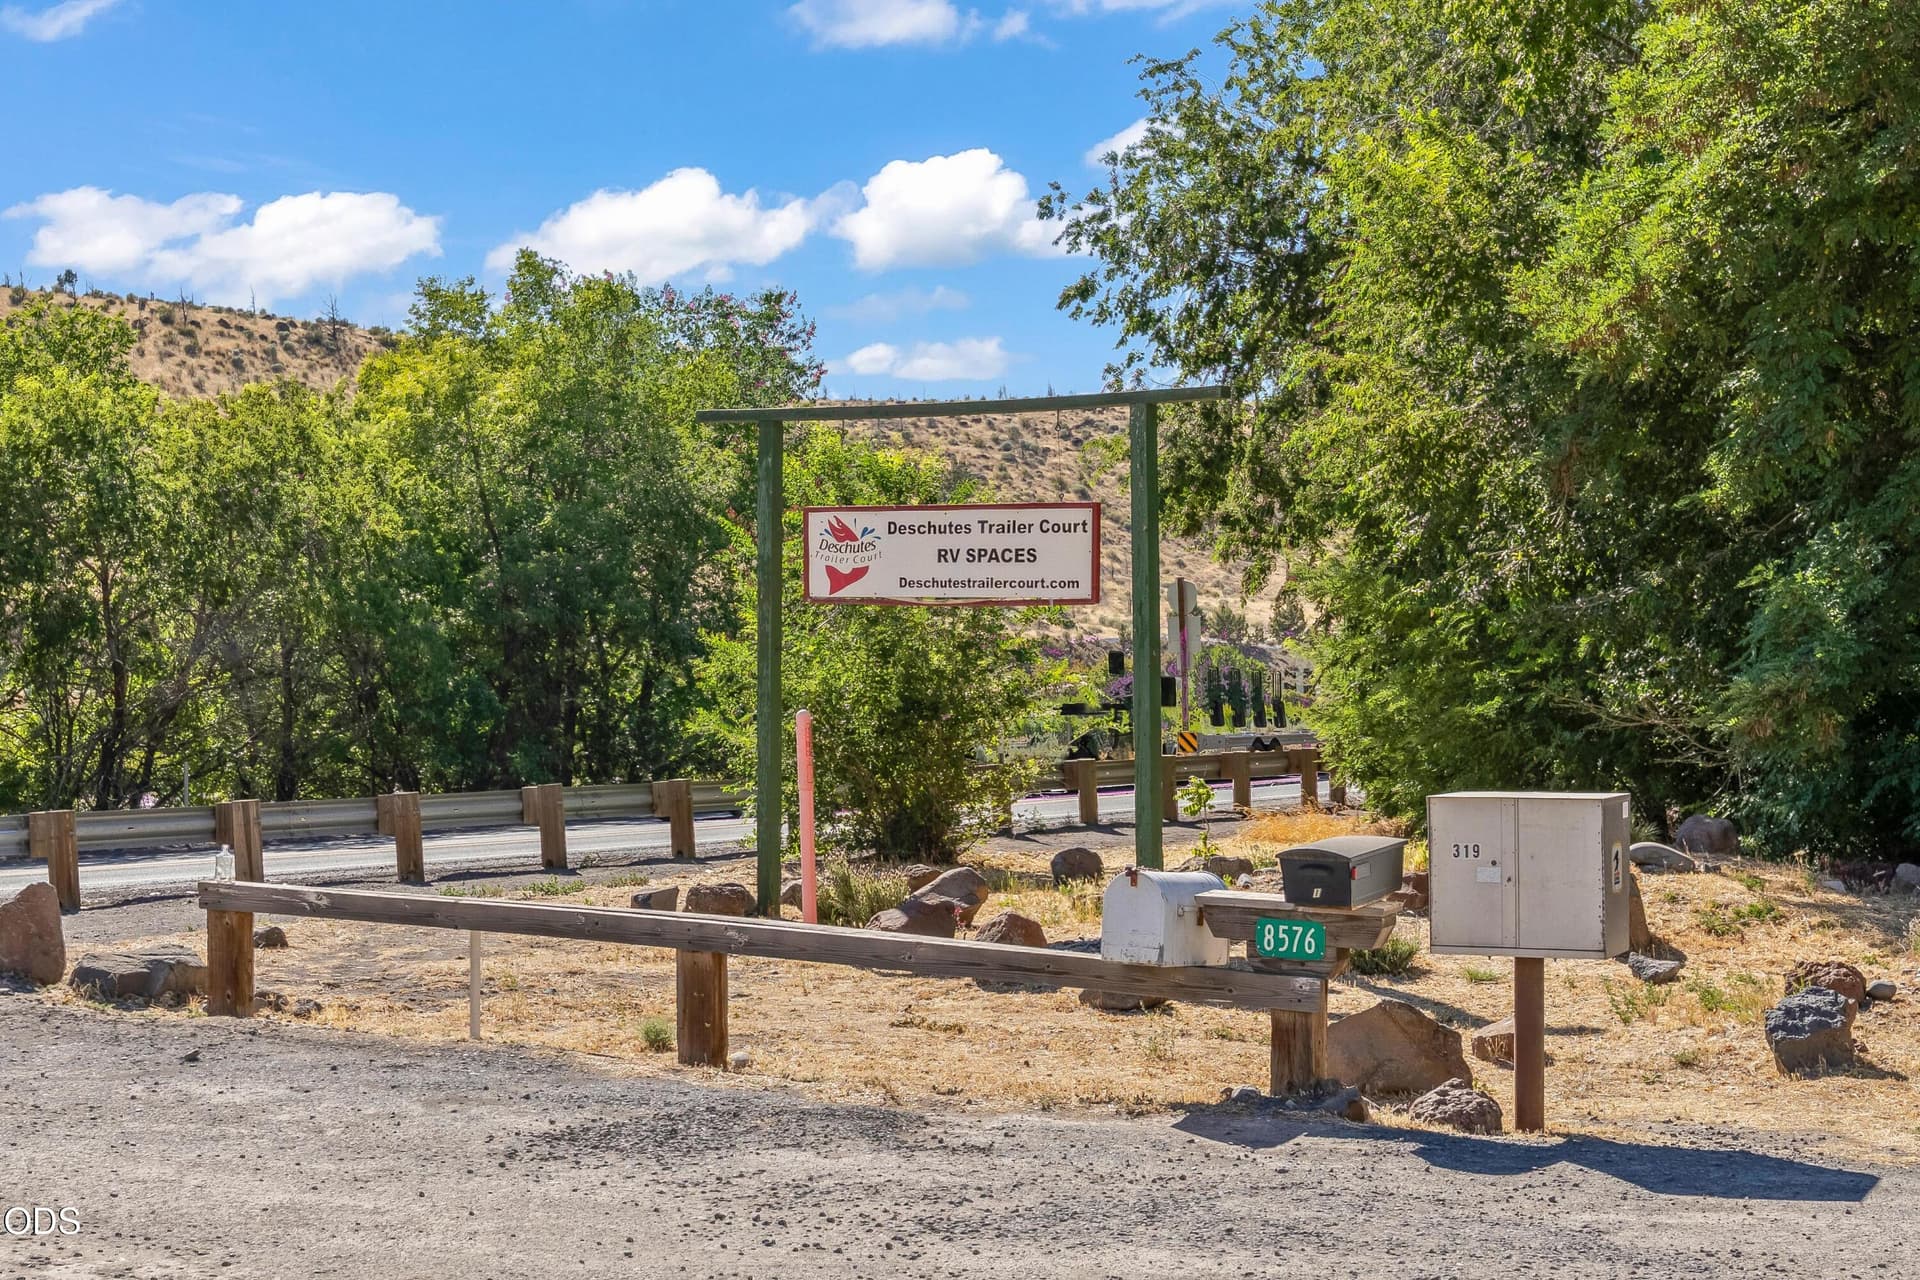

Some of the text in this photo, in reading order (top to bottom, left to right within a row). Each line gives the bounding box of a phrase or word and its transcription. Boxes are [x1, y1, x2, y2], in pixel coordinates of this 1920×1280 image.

[887, 519, 1088, 535] Deschutes Trailer Court
[819, 538, 877, 554] Deschutes
[815, 551, 882, 564] Trailer Court
[937, 548, 1037, 563] RV SPACES
[899, 577, 1080, 590] Deschutestrailercourt.com
[1452, 843, 1480, 858] 319
[1263, 923, 1316, 954] 8576
